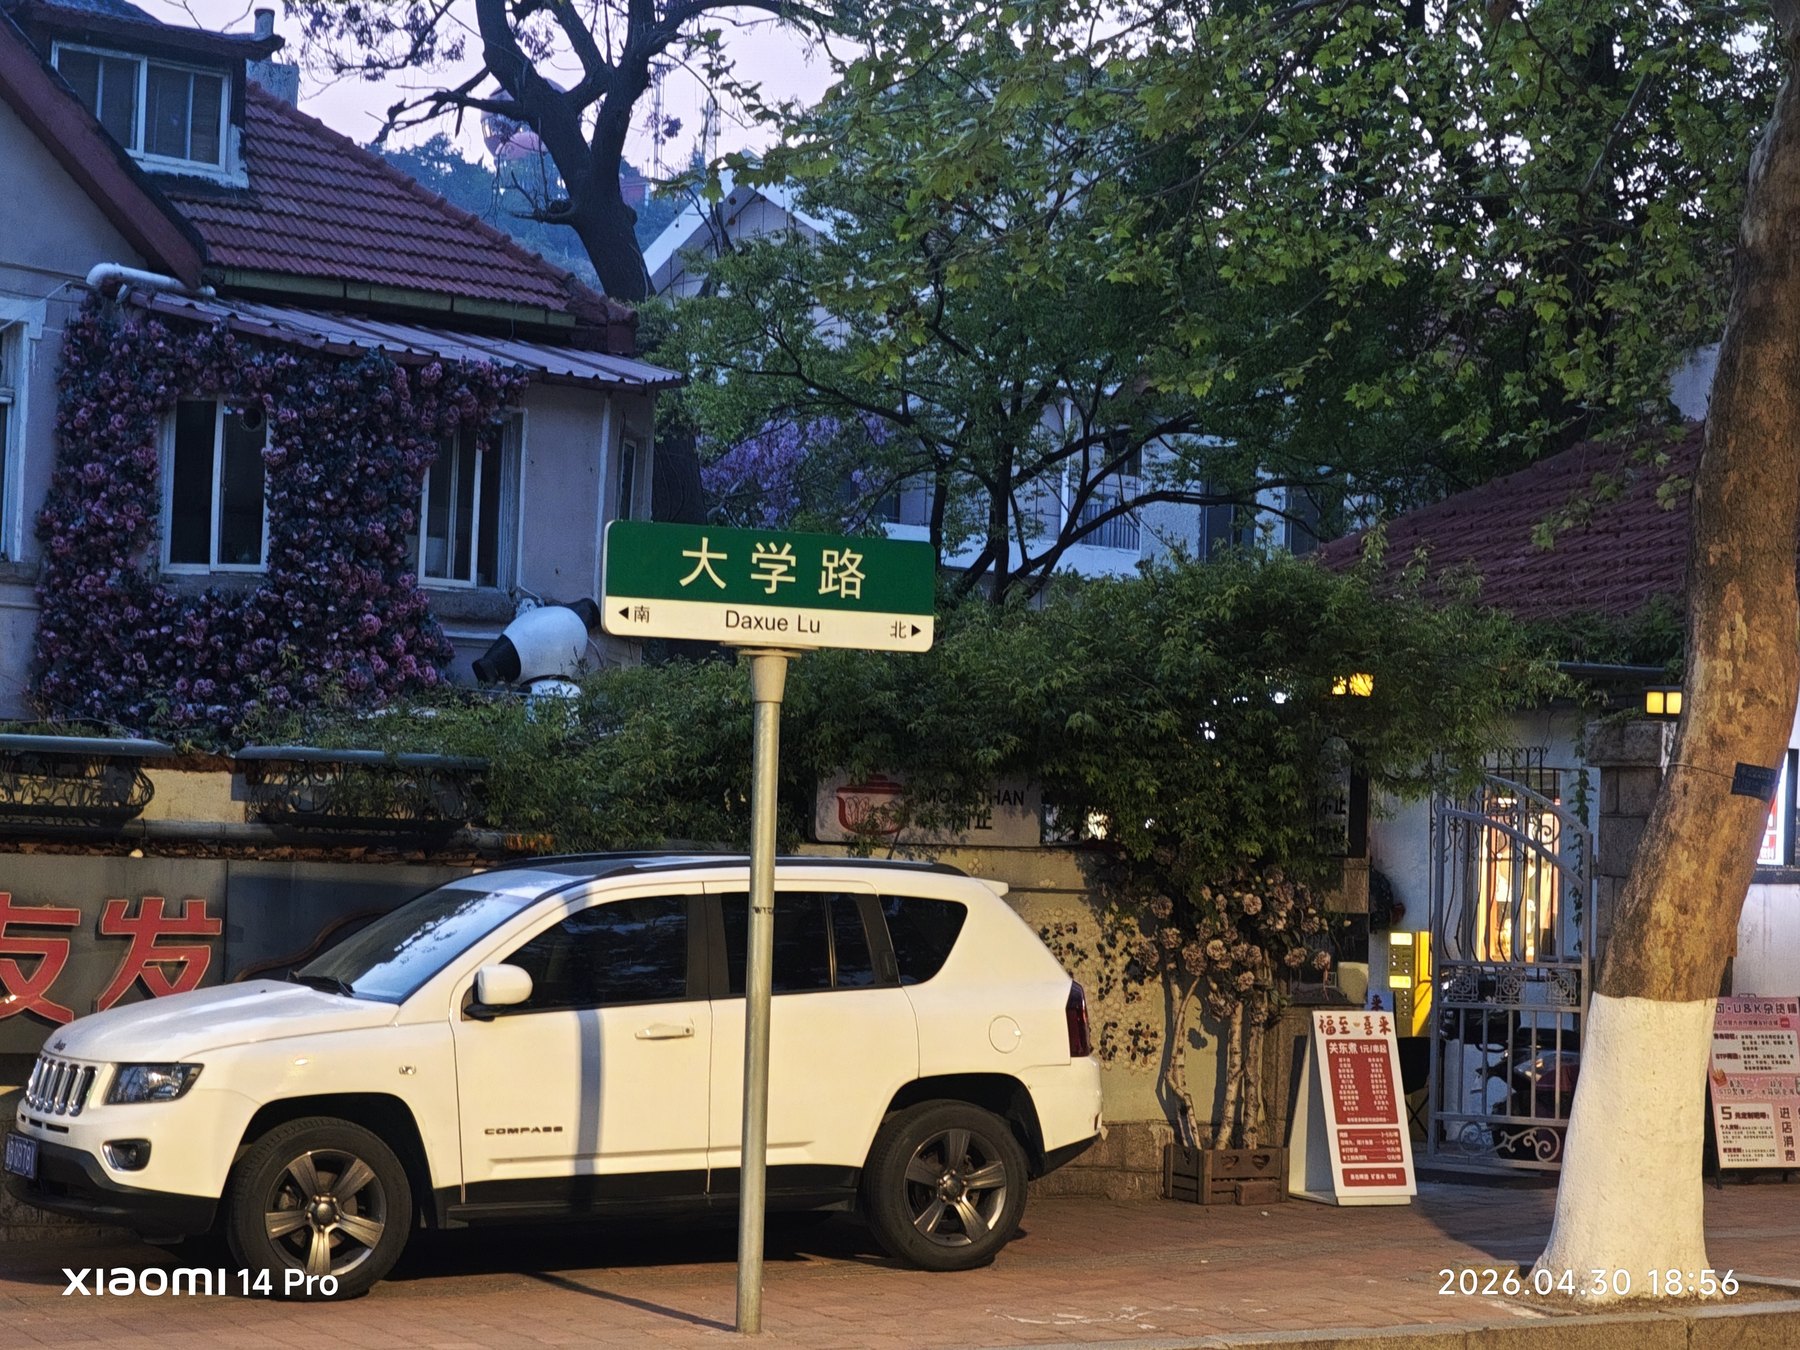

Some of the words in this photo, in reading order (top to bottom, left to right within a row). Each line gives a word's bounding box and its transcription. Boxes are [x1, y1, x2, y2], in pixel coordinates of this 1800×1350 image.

[679, 536, 867, 600] 大学路
[633, 605, 651, 625] 南
[725, 610, 789, 632] Daxue
[797, 614, 821, 634] Lu
[889, 621, 907, 640] 北
[0, 892, 222, 1025] 友发
[1329, 1042, 1358, 1055] 关东煮
[484, 1126, 563, 1135] COMPASS
[1779, 1107, 1796, 1162] 进店消费
